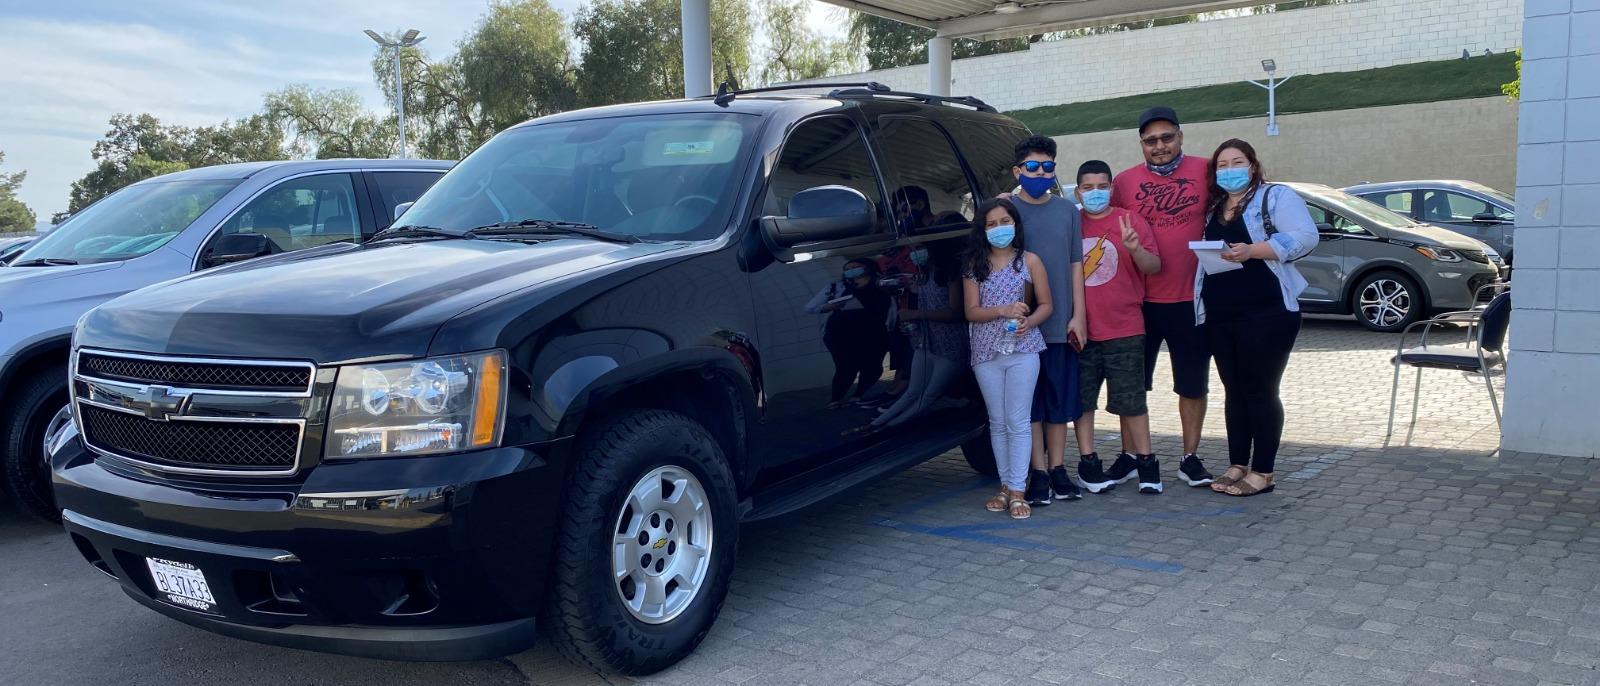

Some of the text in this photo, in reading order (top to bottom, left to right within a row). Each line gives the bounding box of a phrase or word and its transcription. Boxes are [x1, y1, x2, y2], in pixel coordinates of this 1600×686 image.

[1136, 181, 1175, 200] Star
[1154, 188, 1200, 213] Wars
[156, 571, 212, 602] BL37A33
